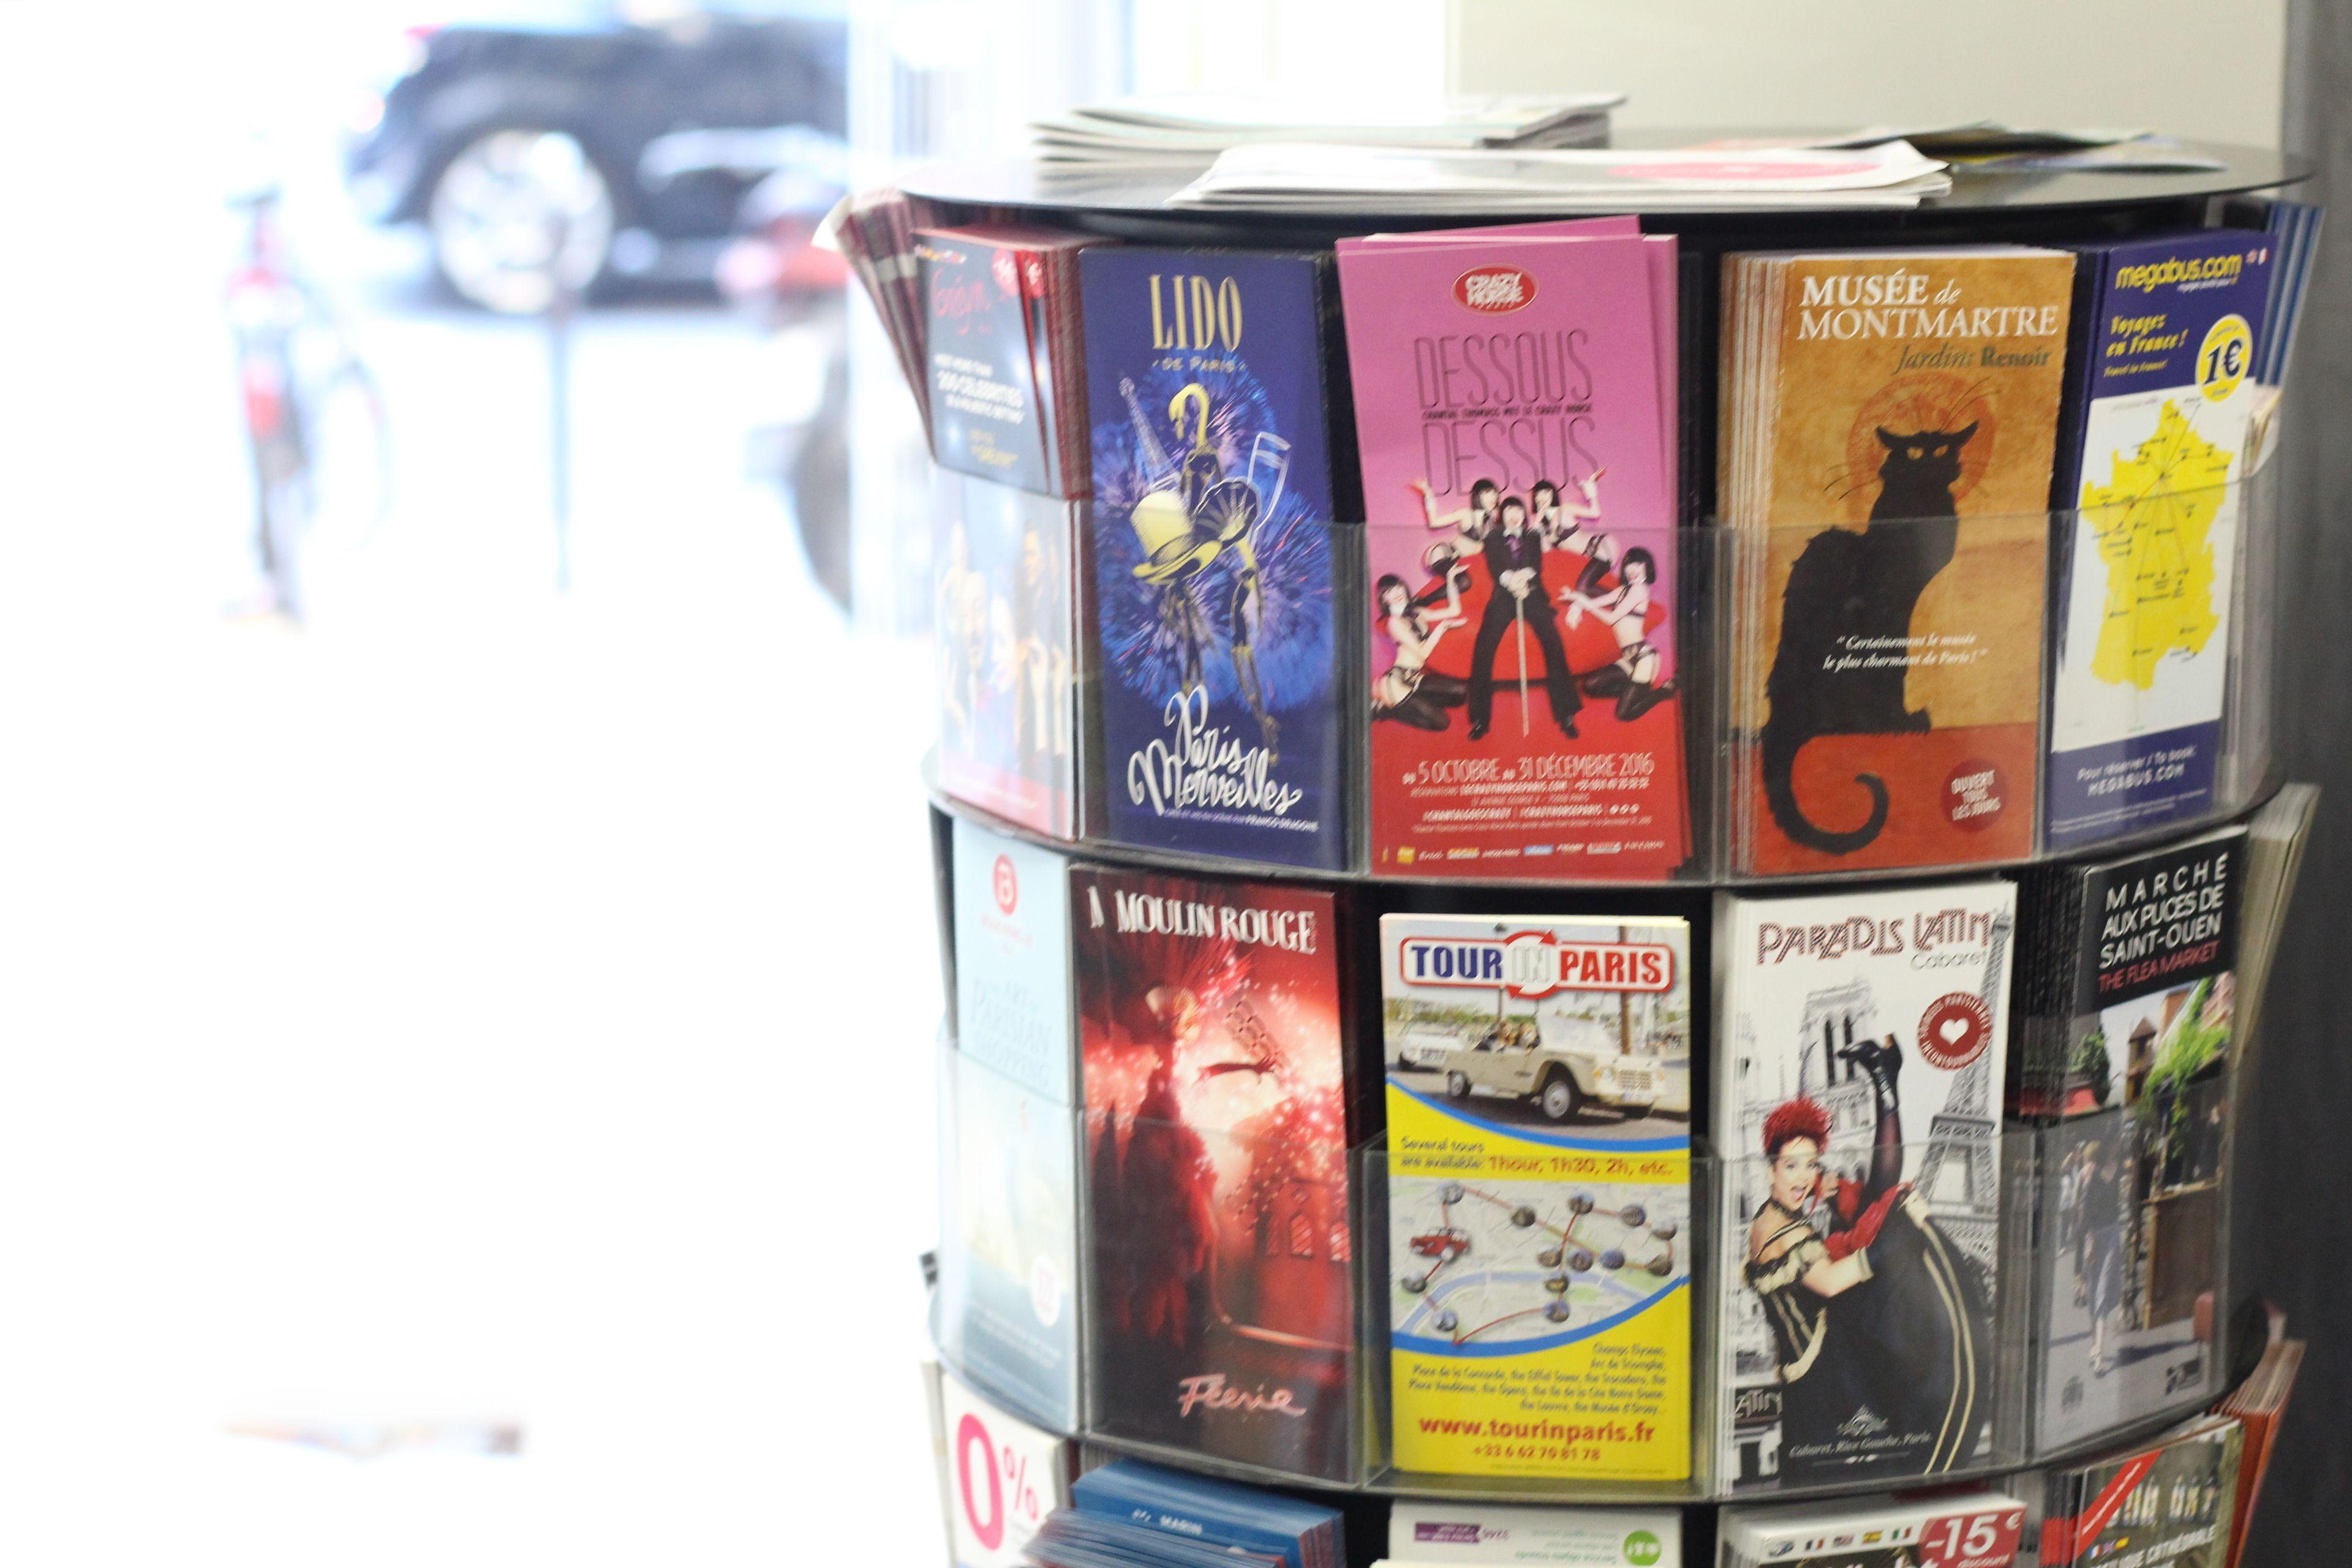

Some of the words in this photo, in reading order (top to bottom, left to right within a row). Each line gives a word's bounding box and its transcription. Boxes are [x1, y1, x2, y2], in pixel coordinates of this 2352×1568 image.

[1799, 267, 1929, 306] MUSÉE
[1932, 278, 1962, 304] de
[2115, 254, 2242, 293] megabus.com
[1150, 274, 1242, 352] LIDO
[1796, 305, 2059, 340] MONTMARTRE
[1414, 328, 1593, 409] DESSOUS
[1980, 345, 2052, 368] Renoir
[2106, 341, 2127, 358] en
[2204, 339, 2241, 384] 1€
[1422, 417, 1598, 496] DESSUS
[1164, 684, 1242, 774] Paris
[1419, 760, 1430, 784] 5
[1431, 758, 1501, 783] OCTOBRE
[1517, 756, 1533, 781] 31
[1536, 752, 1616, 780] DÉCEMBRE
[1618, 752, 1655, 777] 2016
[1114, 890, 1216, 938] MOULIN
[1219, 907, 1317, 956] ROUGE
[2101, 908, 2139, 941] AUX
[2139, 890, 2198, 930] PUCES
[2199, 883, 2226, 912] DE
[1910, 951, 1988, 971] Cabaret
[2099, 911, 2223, 970] SAINT-OUEN
[1411, 945, 1502, 979] TOUR
[1559, 950, 1662, 984] PARIS
[2098, 968, 2126, 993] THE
[2159, 939, 2220, 973] MARKET
[1419, 1418, 1654, 1446] www.tourinparis.fr
